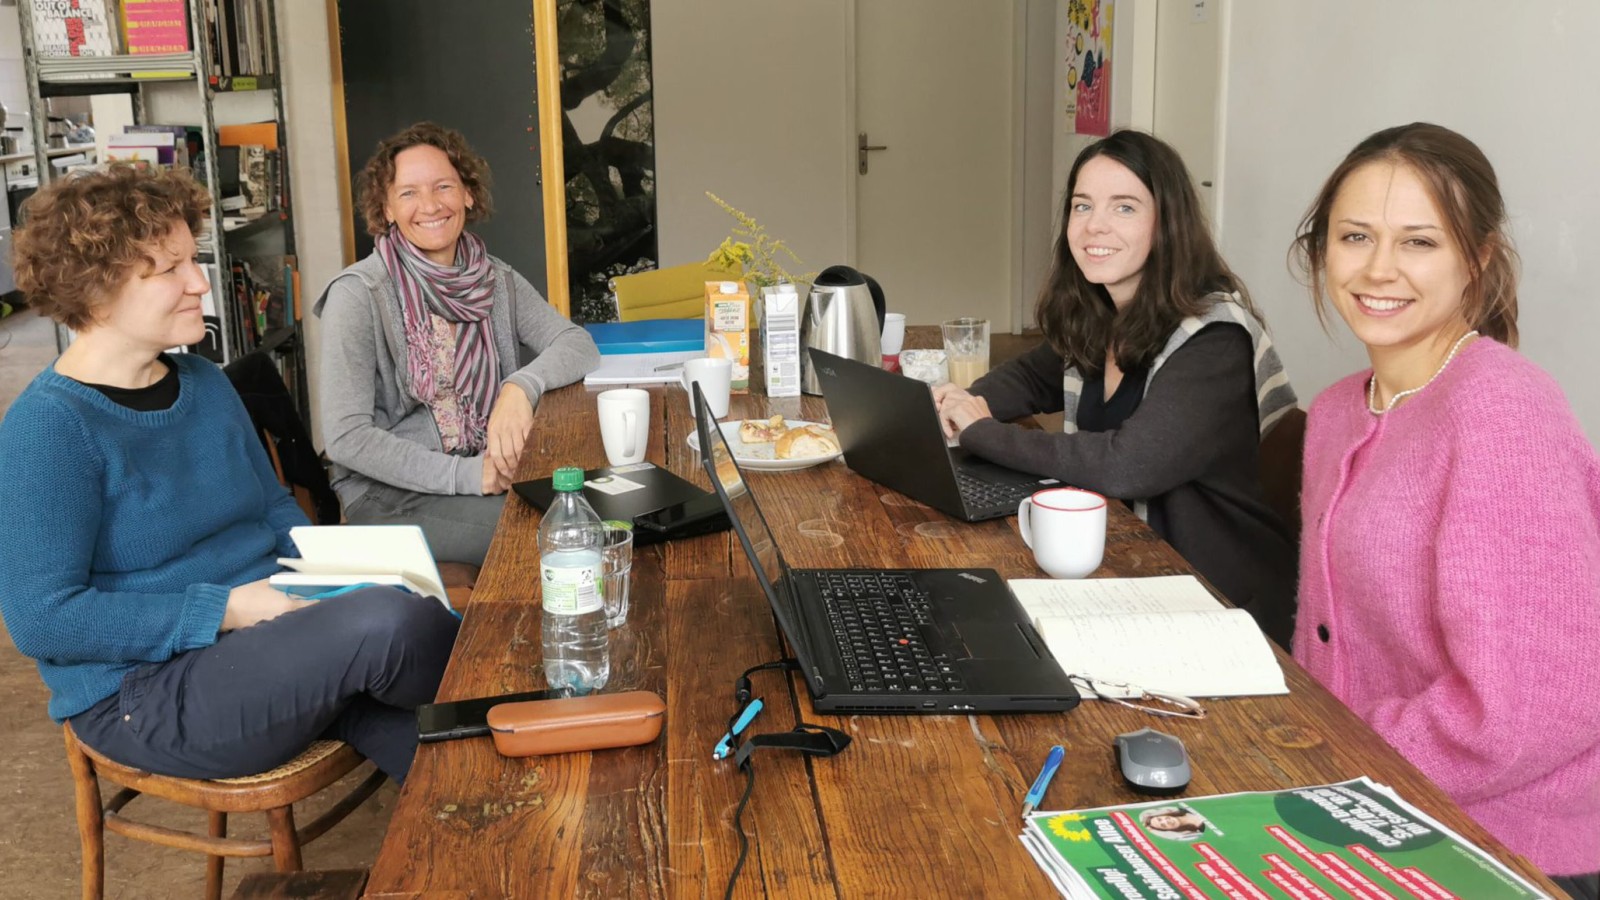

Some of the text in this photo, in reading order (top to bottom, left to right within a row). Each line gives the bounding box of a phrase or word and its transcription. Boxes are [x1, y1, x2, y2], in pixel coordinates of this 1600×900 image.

[36, 1, 70, 10] OUT OF
[47, 9, 93, 18] BALANCE
[1339, 814, 1402, 848] CleanUp!
[1093, 819, 1181, 899] Schönhauser Allee
